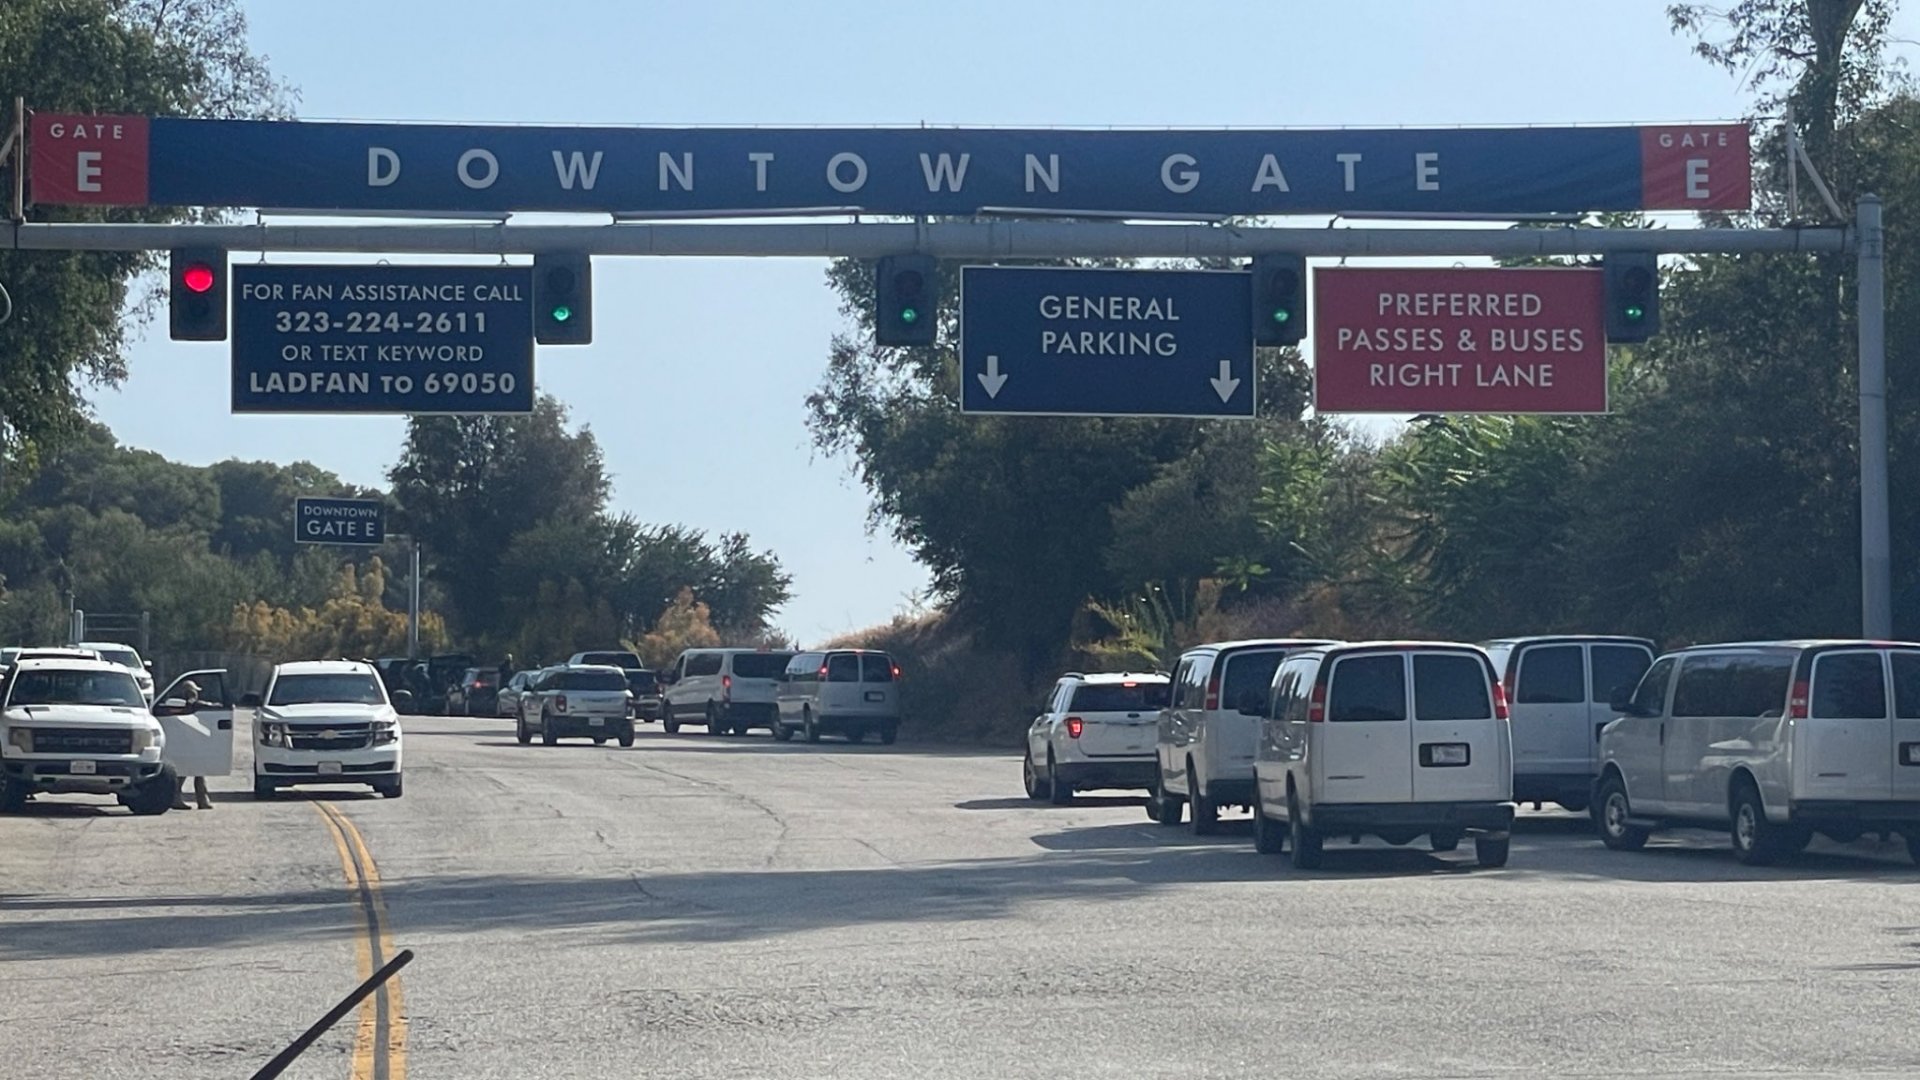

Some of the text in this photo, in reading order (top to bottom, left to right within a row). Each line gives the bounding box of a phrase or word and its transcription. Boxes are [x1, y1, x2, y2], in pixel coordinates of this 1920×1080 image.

[50, 122, 125, 139] GATE
[1659, 132, 1727, 148] GATE
[77, 151, 102, 192] E
[368, 147, 1440, 193] DOWNTOWN GATE
[1686, 158, 1710, 199] E
[242, 283, 523, 302] FOR FAN ASSISTANCE CALL
[1039, 295, 1180, 321] GENERAL
[1379, 293, 1542, 317] PREFERRED
[276, 311, 486, 333] 323-224-2611
[1042, 331, 1177, 356] PARKING
[1338, 328, 1584, 352] PASSES & BUSES
[281, 344, 483, 362] OR TEXT KEYWORD
[250, 372, 516, 394] LADFAN TO 69050
[1370, 363, 1553, 387] RIGHT LANE
[304, 505, 378, 518] DOWNTOWN
[306, 519, 375, 537] GATE E
